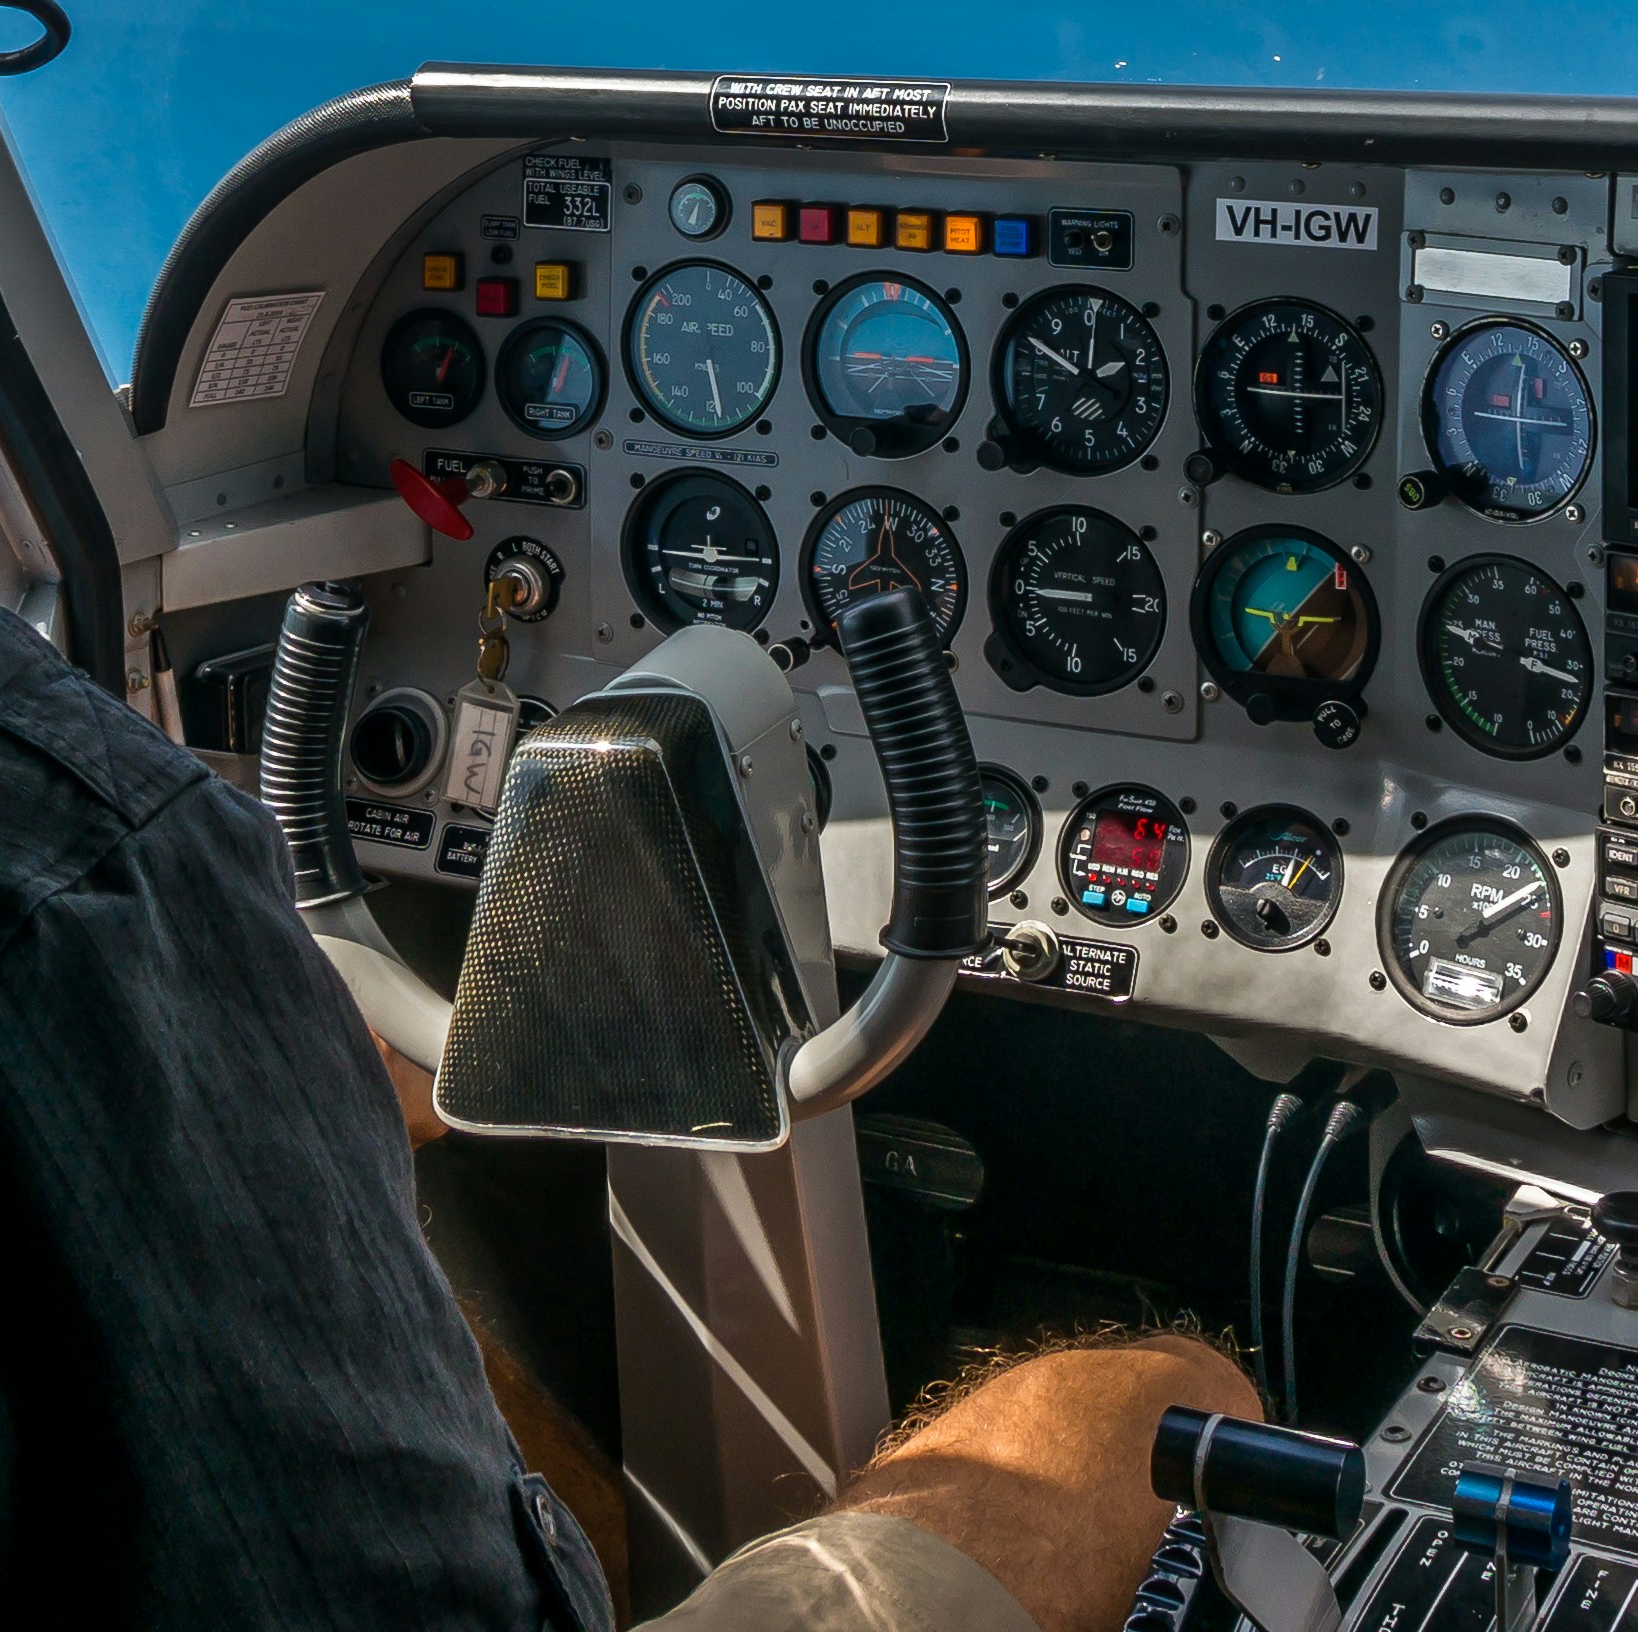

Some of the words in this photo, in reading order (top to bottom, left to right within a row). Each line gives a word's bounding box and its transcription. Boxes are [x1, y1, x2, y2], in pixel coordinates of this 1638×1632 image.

[730, 82, 762, 94] WITH
[766, 84, 801, 96] CREW
[806, 85, 838, 97] SEAT
[844, 87, 859, 97] IN
[862, 88, 890, 100] AFT
[893, 89, 932, 101] MOST
[719, 96, 776, 111] POSITION
[781, 101, 805, 113] PAX
[810, 101, 844, 114] SEAT
[849, 103, 936, 118] IMMEDIATELY
[752, 115, 775, 127] AFT
[781, 116, 798, 127] TO
[804, 117, 819, 129] BE
[824, 119, 905, 132] UNOCCUPIED
[526, 157, 556, 167] CHECK
[559, 160, 581, 168] FUEL
[525, 168, 545, 177] WITH
[549, 170, 575, 179] WINGS
[579, 171, 604, 180] LEVEL
[528, 183, 555, 192] TOTAL
[560, 184, 599, 196] USEABLE
[529, 195, 550, 205] FUEL
[564, 197, 600, 216] 332L
[950, 228, 970, 236] PITOT
[1226, 205, 1372, 244] VH-IGW
[951, 236, 971, 244] HEAT
[672, 295, 691, 306] 200
[718, 289, 732, 301] 40
[734, 306, 748, 317] 60
[1051, 319, 1062, 334] 9
[1136, 349, 1145, 365] 2
[413, 396, 429, 404] LEFT
[433, 397, 449, 405] TANK
[529, 408, 549, 416] RIGHT
[552, 410, 571, 418] TANK
[438, 459, 466, 473] FUEL
[523, 466, 543, 474] PUSH
[521, 486, 544, 495] PRIME
[1072, 517, 1086, 532] 10
[522, 541, 541, 559] BOTH
[539, 552, 560, 574] START
[1128, 546, 1140, 560] 15
[1054, 572, 1086, 583] VERTICAL
[1092, 577, 1115, 586] SPEED
[1530, 628, 1553, 640] FUEL
[1317, 706, 1336, 722] PULL
[1330, 720, 1341, 729] TO
[1337, 727, 1355, 744] CAGE
[464, 730, 496, 794] IGW
[366, 808, 391, 820] CABIN
[394, 813, 409, 823] AIR
[348, 820, 381, 835] ROTATE
[384, 827, 401, 839] FOR
[404, 831, 419, 842] AIR
[447, 852, 478, 864] BATTERY
[1609, 850, 1633, 863] IDENT
[1502, 864, 1520, 879] 20
[1089, 884, 1105, 892] STEP
[1471, 883, 1503, 902] RPM
[1614, 883, 1630, 895] VFR
[1134, 892, 1151, 900] AUTO
[1063, 944, 1126, 963] ALTERNATE
[1455, 953, 1486, 968] HOURS
[1070, 960, 1111, 975] STATIC
[1505, 963, 1523, 978] 35
[1066, 975, 1110, 990] SOURCE
[1599, 1368, 1635, 1381] DOORS
[1493, 1429, 1515, 1440] THE
[1518, 1435, 1580, 1455] MARKINGS
[1584, 1450, 1609, 1460] AND
[1476, 1451, 1502, 1462] THIS
[1505, 1458, 1566, 1477] AIRCRAFT
[1588, 1477, 1611, 1488] THE
[1420, 1530, 1448, 1568] OPEN
[1580, 1569, 1609, 1610] FINE
